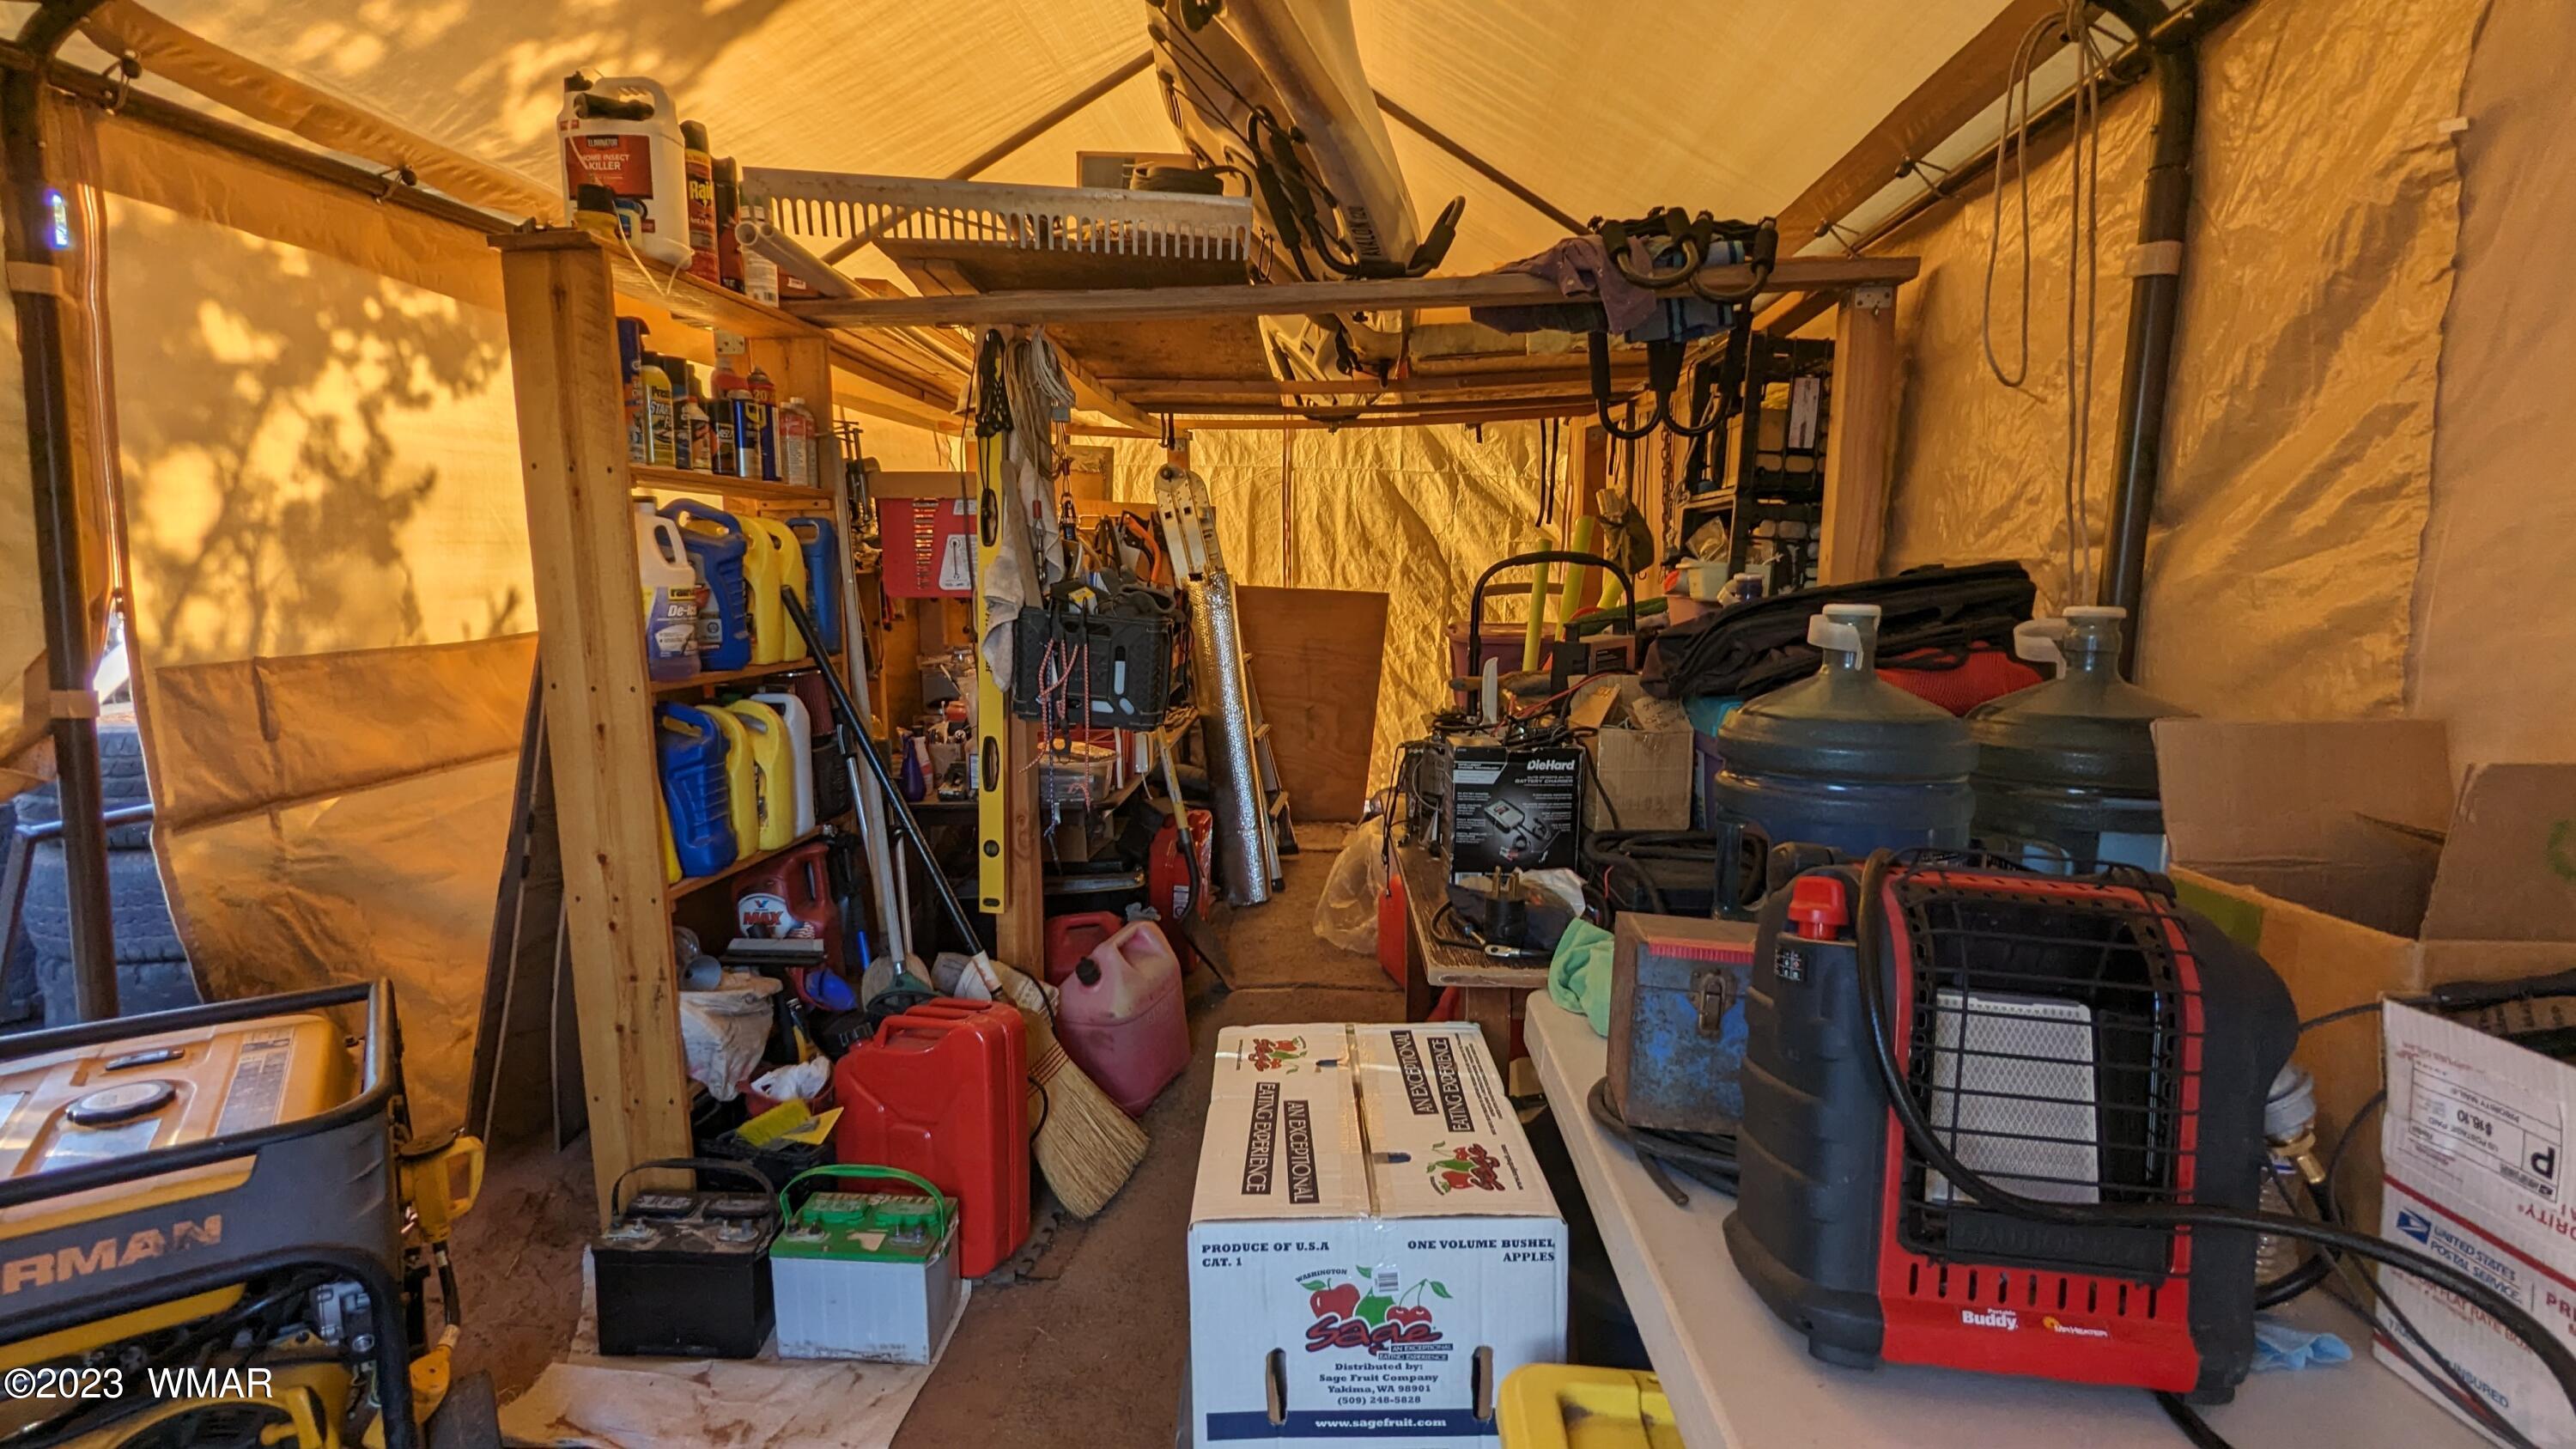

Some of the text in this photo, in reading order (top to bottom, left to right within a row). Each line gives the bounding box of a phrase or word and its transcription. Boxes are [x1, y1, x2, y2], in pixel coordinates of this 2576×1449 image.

[589, 161, 622, 171] KILLER
[1527, 758, 1575, 770] DieHard
[744, 911, 783, 925] MAX
[1395, 1033, 1435, 1115] AN EXCEPTIONAL
[1431, 1038, 1471, 1131] EATING EXPERIENCE
[1246, 1083, 1276, 1193] EATING EXPERIENCE
[1288, 1102, 1314, 1202] AN EXCEPTIONAL
[2530, 1146, 2556, 1180] P
[1202, 1241, 1330, 1254] PRODUCE OF U.S.A
[1407, 1239, 1555, 1250] ONE VOLUME BUSHEL
[1503, 1251, 1555, 1262] APPLES
[2431, 1240, 2469, 1271] POSTAL
[2434, 1227, 2516, 1281] UNITED STATES
[1202, 1257, 1242, 1268] CAT. 1
[1295, 1269, 1348, 1283] WASHINGTON
[1304, 1314, 1443, 1357] Sage
[1405, 1343, 1453, 1352] EXCEPTIONAL
[1406, 1363, 1423, 1373] by:
[1319, 1373, 1439, 1384] Sage Fruit Company
[1327, 1385, 1376, 1394] Yakima,
[1337, 1396, 1421, 1405] (509) 248-5828
[1315, 1417, 1447, 1429] www.sagefruit.com
